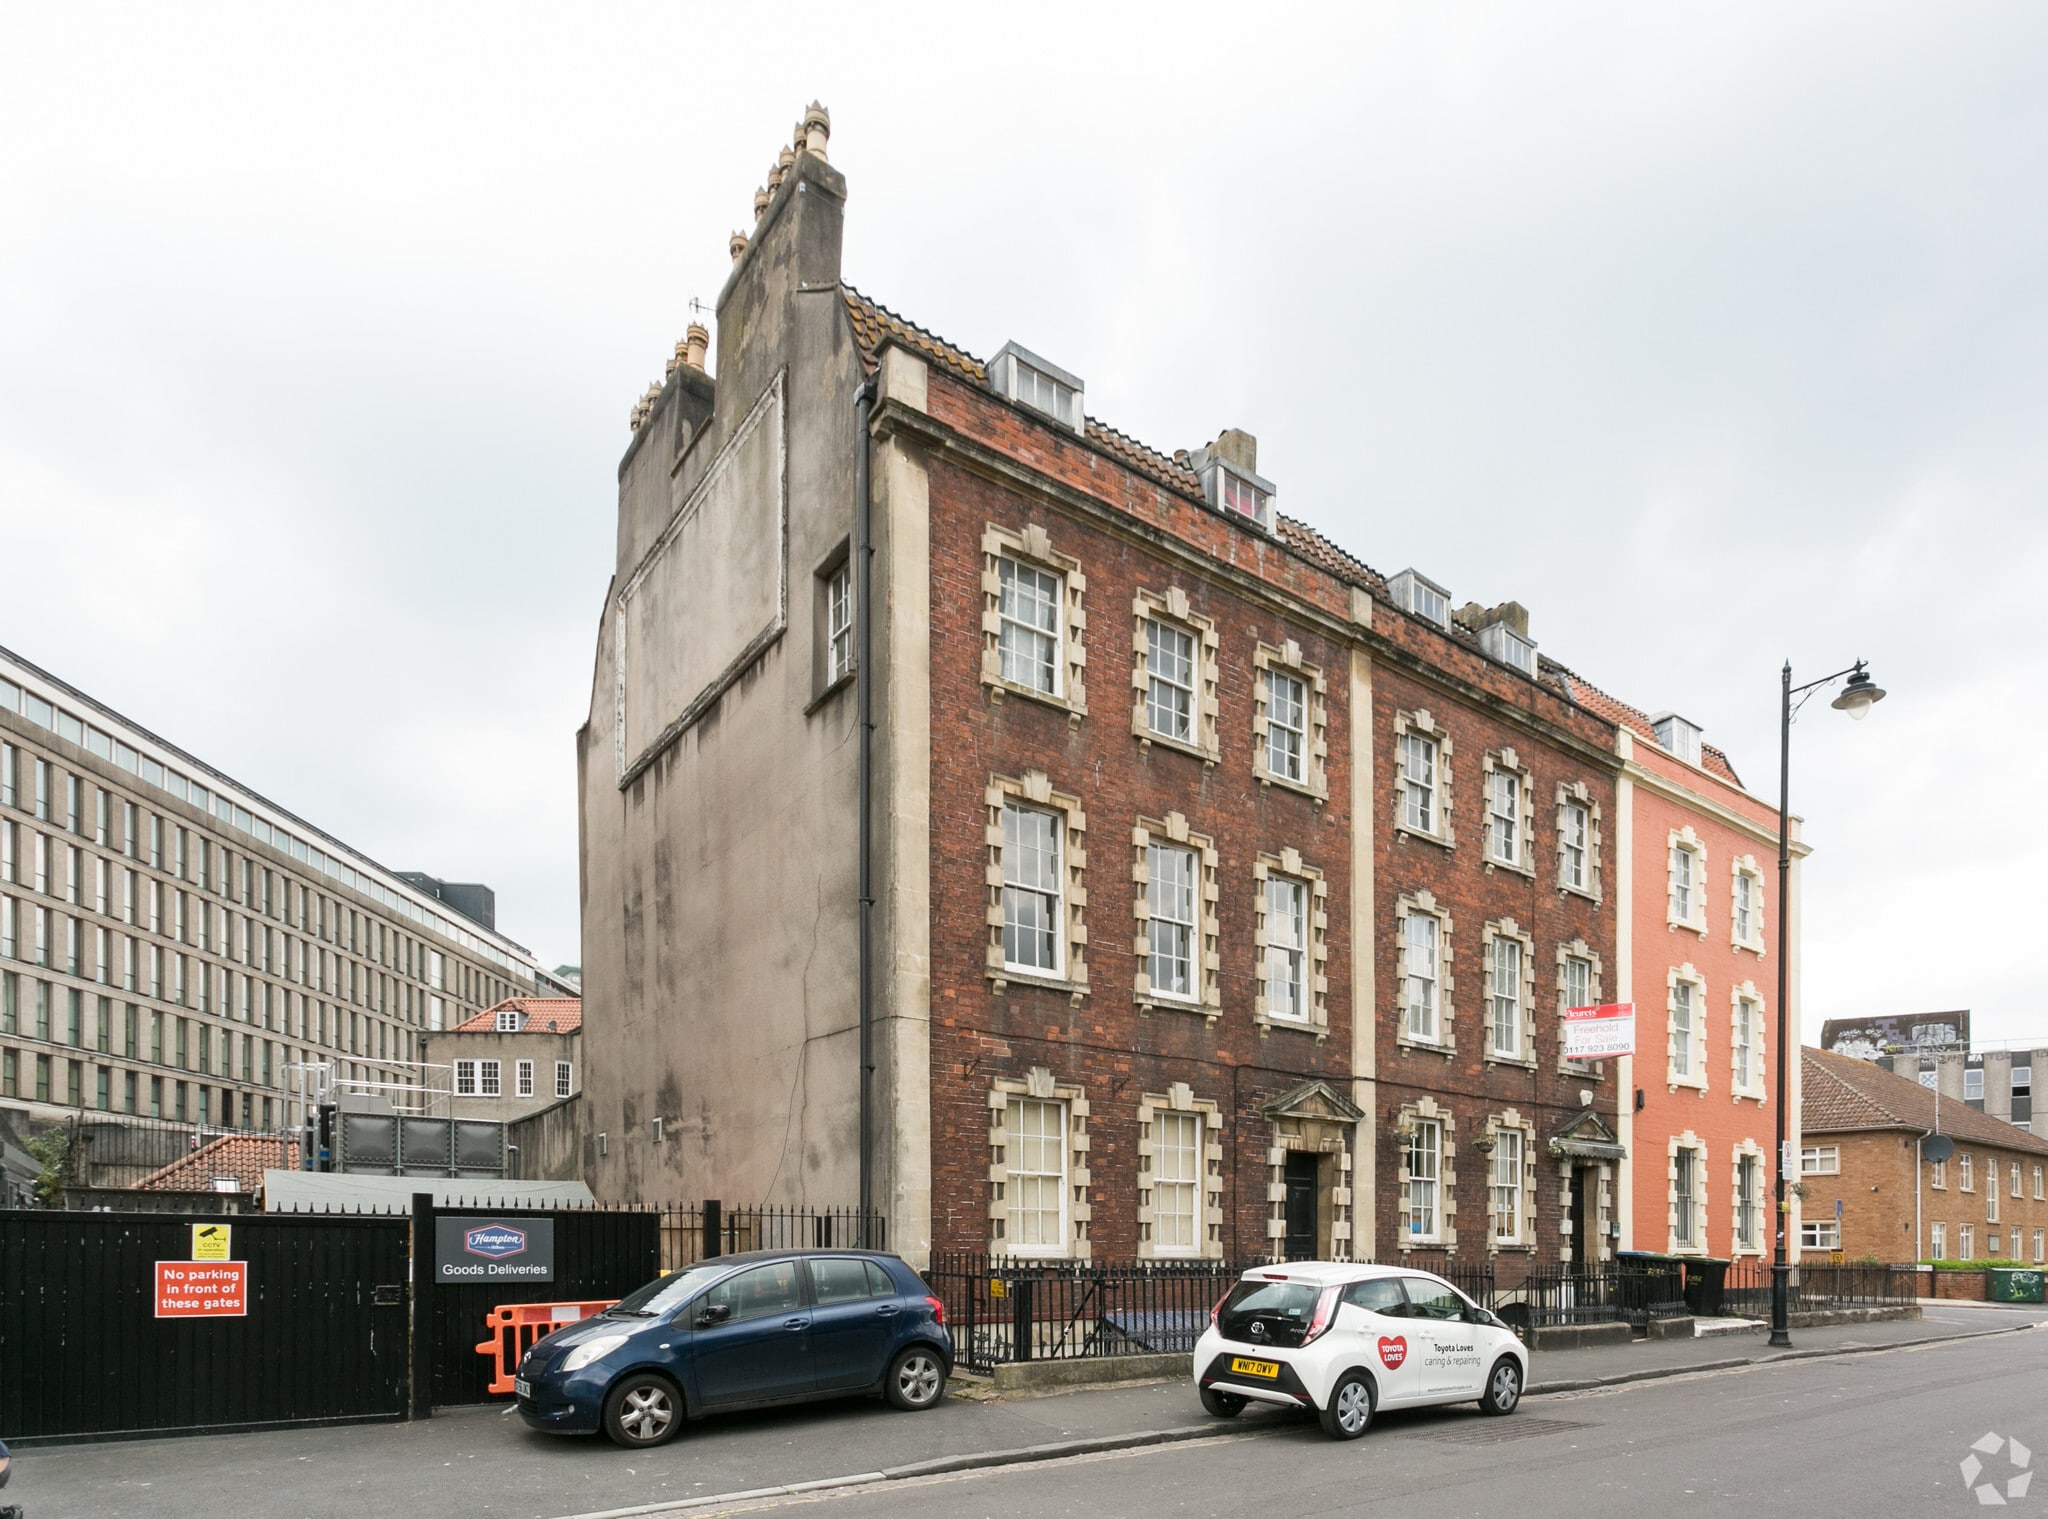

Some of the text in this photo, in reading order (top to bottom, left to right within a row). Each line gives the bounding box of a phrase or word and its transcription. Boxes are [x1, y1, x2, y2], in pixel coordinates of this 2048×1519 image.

[1566, 1009, 1597, 1018] leurets
[1574, 1024, 1618, 1034] Freehold
[1575, 1034, 1618, 1044] For Sale
[1587, 1044, 1605, 1052] 923
[1607, 1043, 1630, 1051] 8090
[469, 1233, 522, 1244] Hampton
[442, 1263, 548, 1275] Goods Deliveries
[163, 1269, 239, 1281] No parking
[166, 1283, 236, 1294] in front of
[161, 1297, 240, 1310] these gates
[1381, 1344, 1404, 1353] TOYOTA
[1433, 1343, 1474, 1354] Toyota Loves
[1384, 1353, 1403, 1362] LOVES
[1424, 1355, 1481, 1368] caring & repairing
